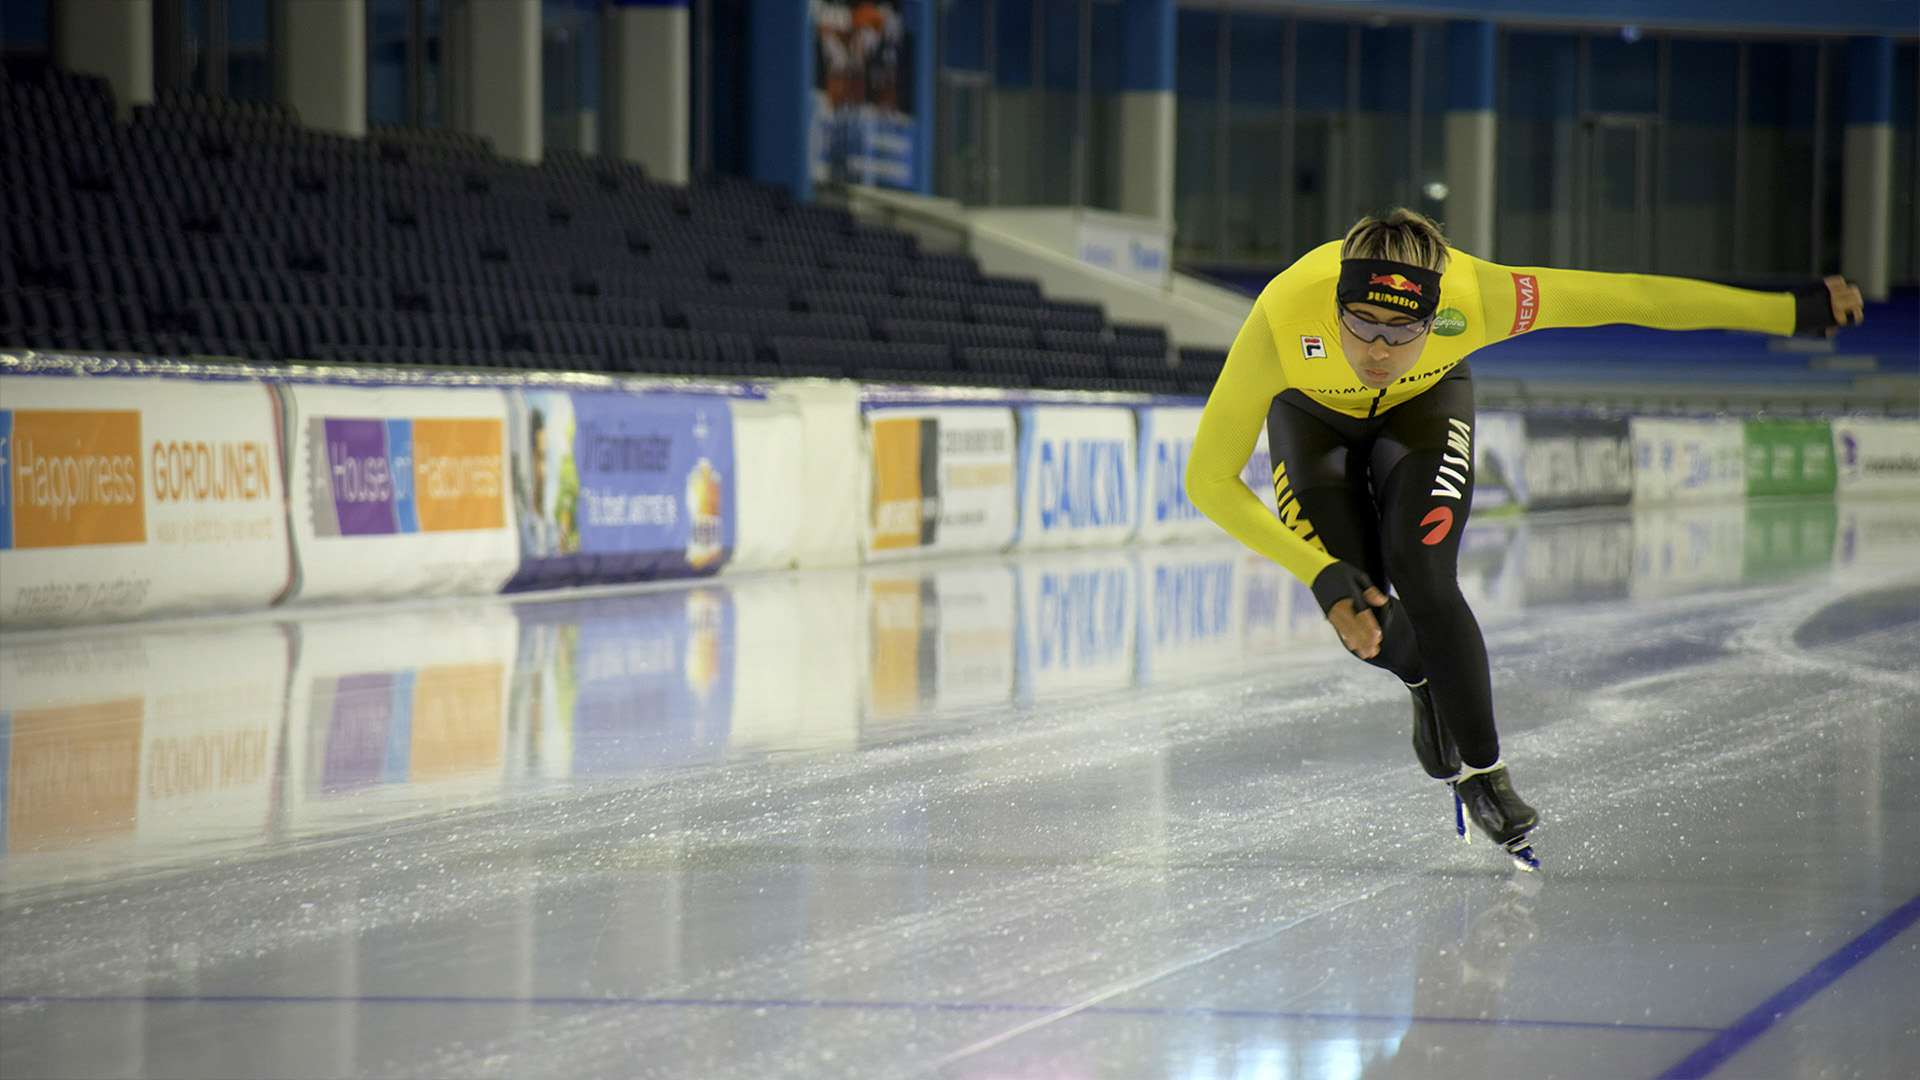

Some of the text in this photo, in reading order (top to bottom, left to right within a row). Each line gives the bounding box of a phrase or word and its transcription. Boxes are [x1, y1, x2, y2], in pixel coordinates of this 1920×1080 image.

[1366, 291, 1419, 311] JUMBO
[1432, 315, 1465, 330] Campina
[1515, 276, 1535, 333] HEMA
[17, 439, 137, 522] Happiness
[153, 440, 270, 504] GORDIJNEN
[330, 440, 391, 503] House
[1040, 438, 1127, 528] DAIKIN
[1430, 417, 1471, 500] VISMA
